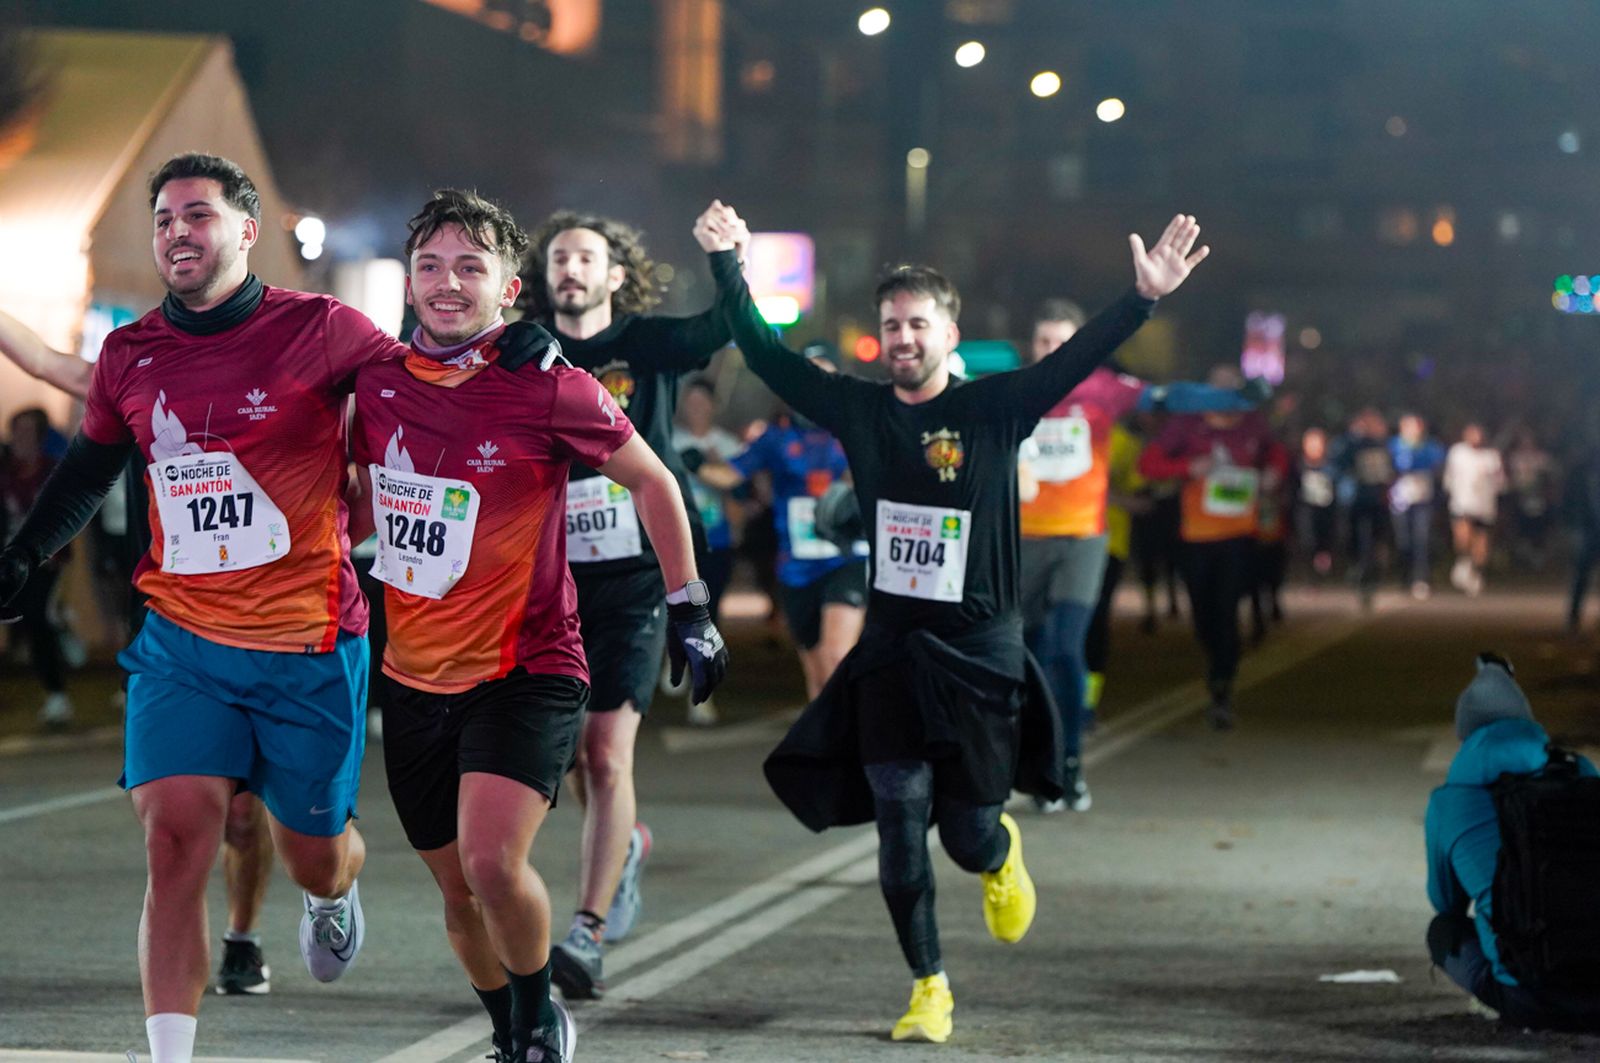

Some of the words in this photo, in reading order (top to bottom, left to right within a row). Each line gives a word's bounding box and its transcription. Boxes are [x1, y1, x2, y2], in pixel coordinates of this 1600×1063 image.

[254, 405, 278, 413] RURAL
[181, 467, 214, 481] NOCHE
[216, 465, 231, 477] DE
[170, 484, 194, 497] SAN
[195, 477, 232, 495] ANTÓN
[386, 482, 417, 499] NOCHE
[418, 488, 433, 501] DE
[187, 492, 254, 533] 1247
[378, 493, 392, 508] SAN
[393, 498, 431, 516] ANTÓN
[213, 533, 230, 542] Fran
[385, 512, 447, 557] 1248
[398, 552, 423, 566] Leandro
[890, 536, 946, 567] 6704
